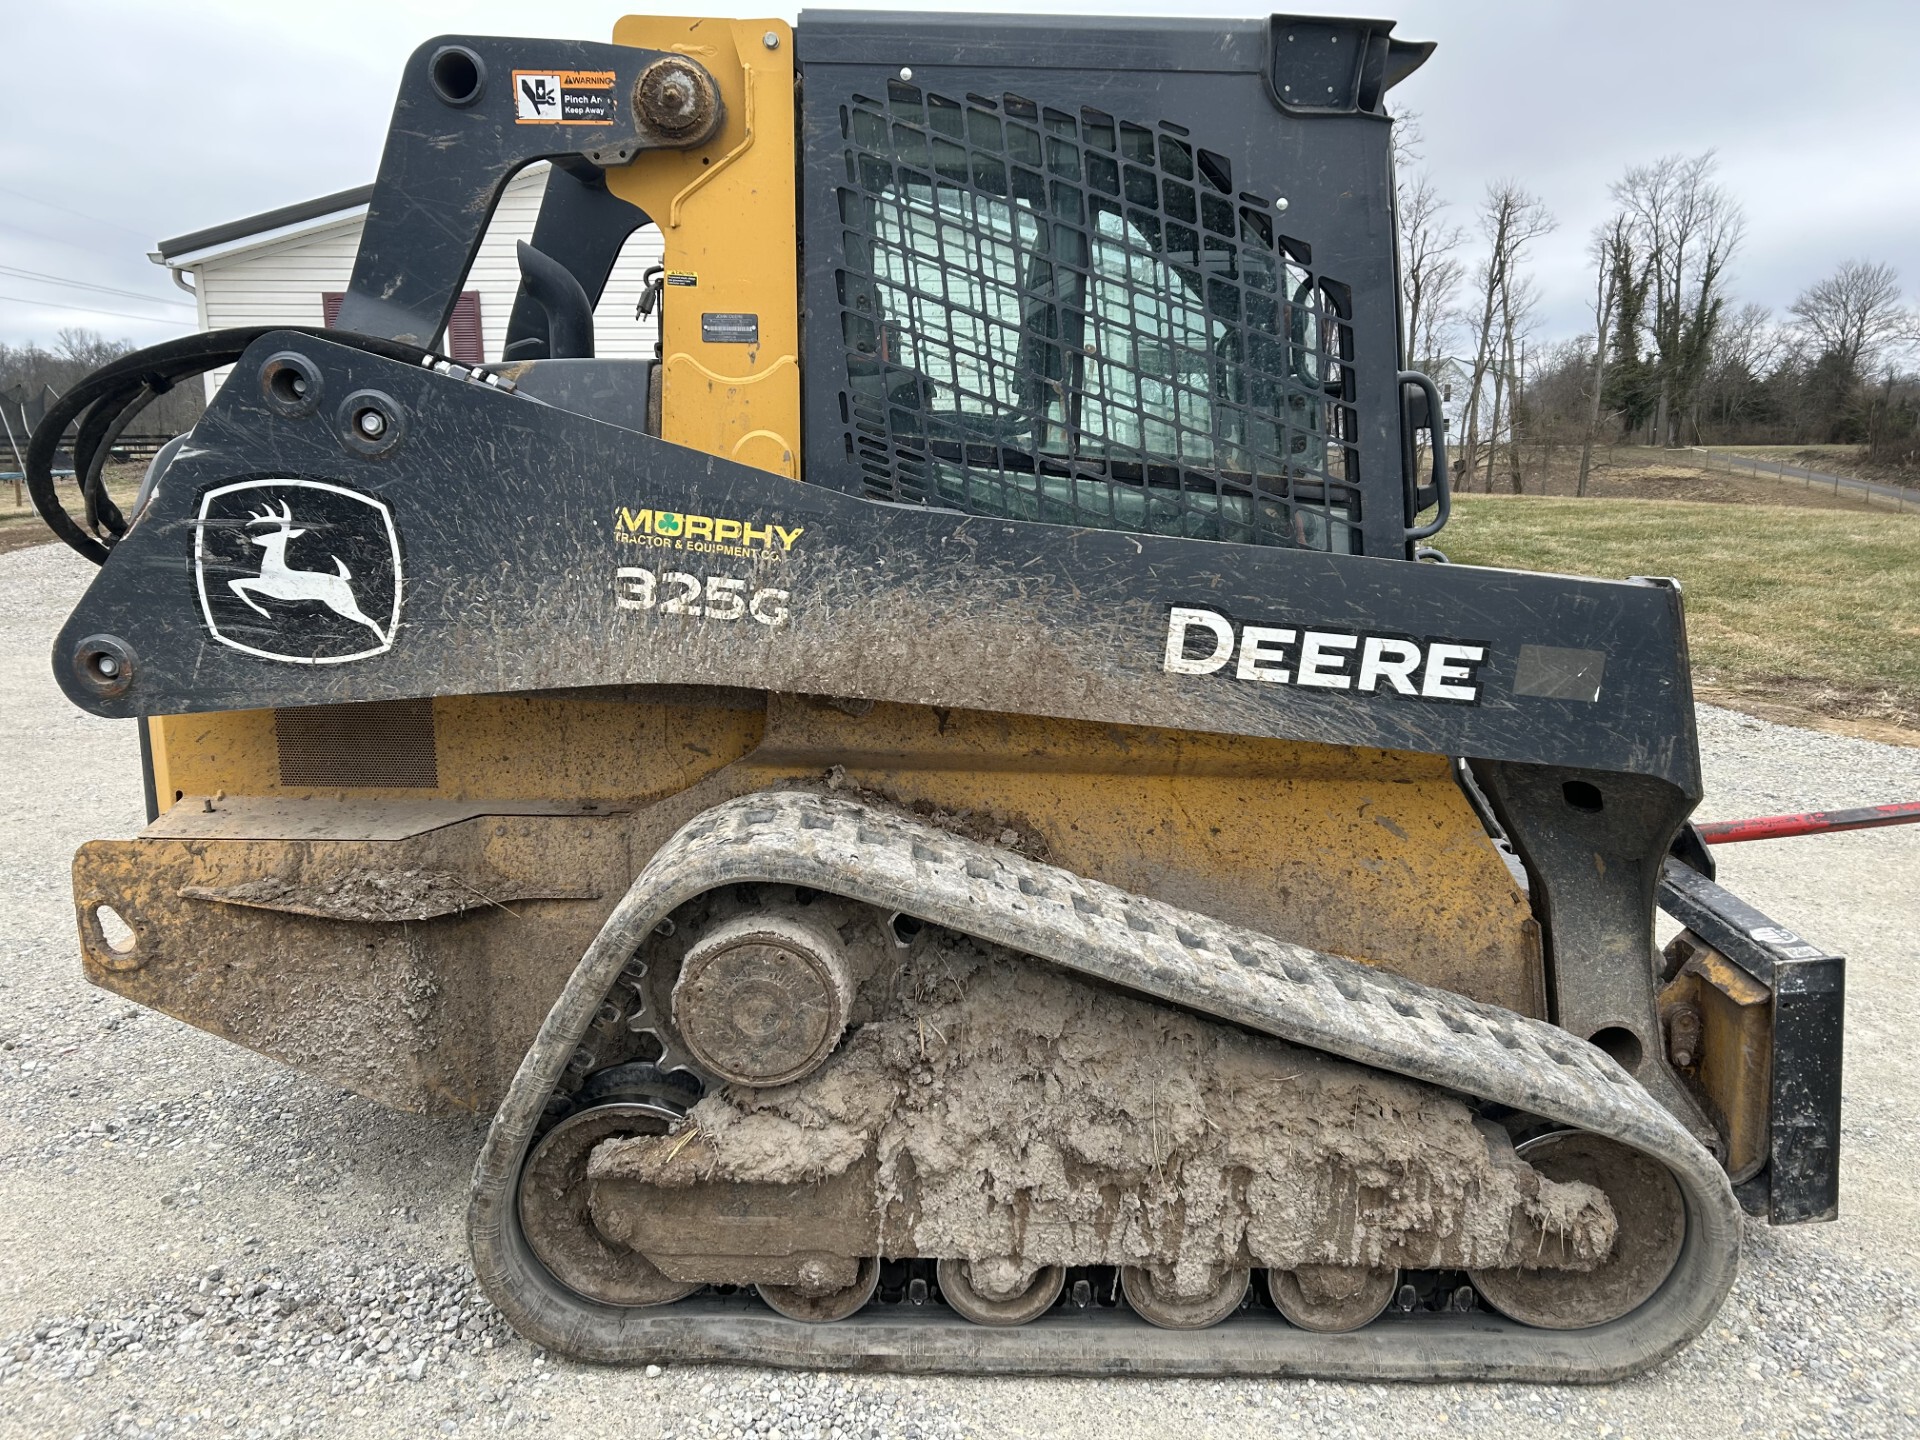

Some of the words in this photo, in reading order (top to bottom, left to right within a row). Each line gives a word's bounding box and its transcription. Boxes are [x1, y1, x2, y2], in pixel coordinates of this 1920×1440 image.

[572, 77, 611, 85] WARNING
[564, 95, 589, 103] Pinch
[565, 106, 584, 115] Keep
[585, 107, 605, 116] Away
[614, 506, 804, 551] MURPHY
[614, 532, 671, 548] TRACTOR
[675, 540, 683, 549] &
[686, 541, 756, 558] EQUIPMENT
[616, 567, 790, 626] 325G
[1163, 606, 1484, 701] DEERE
